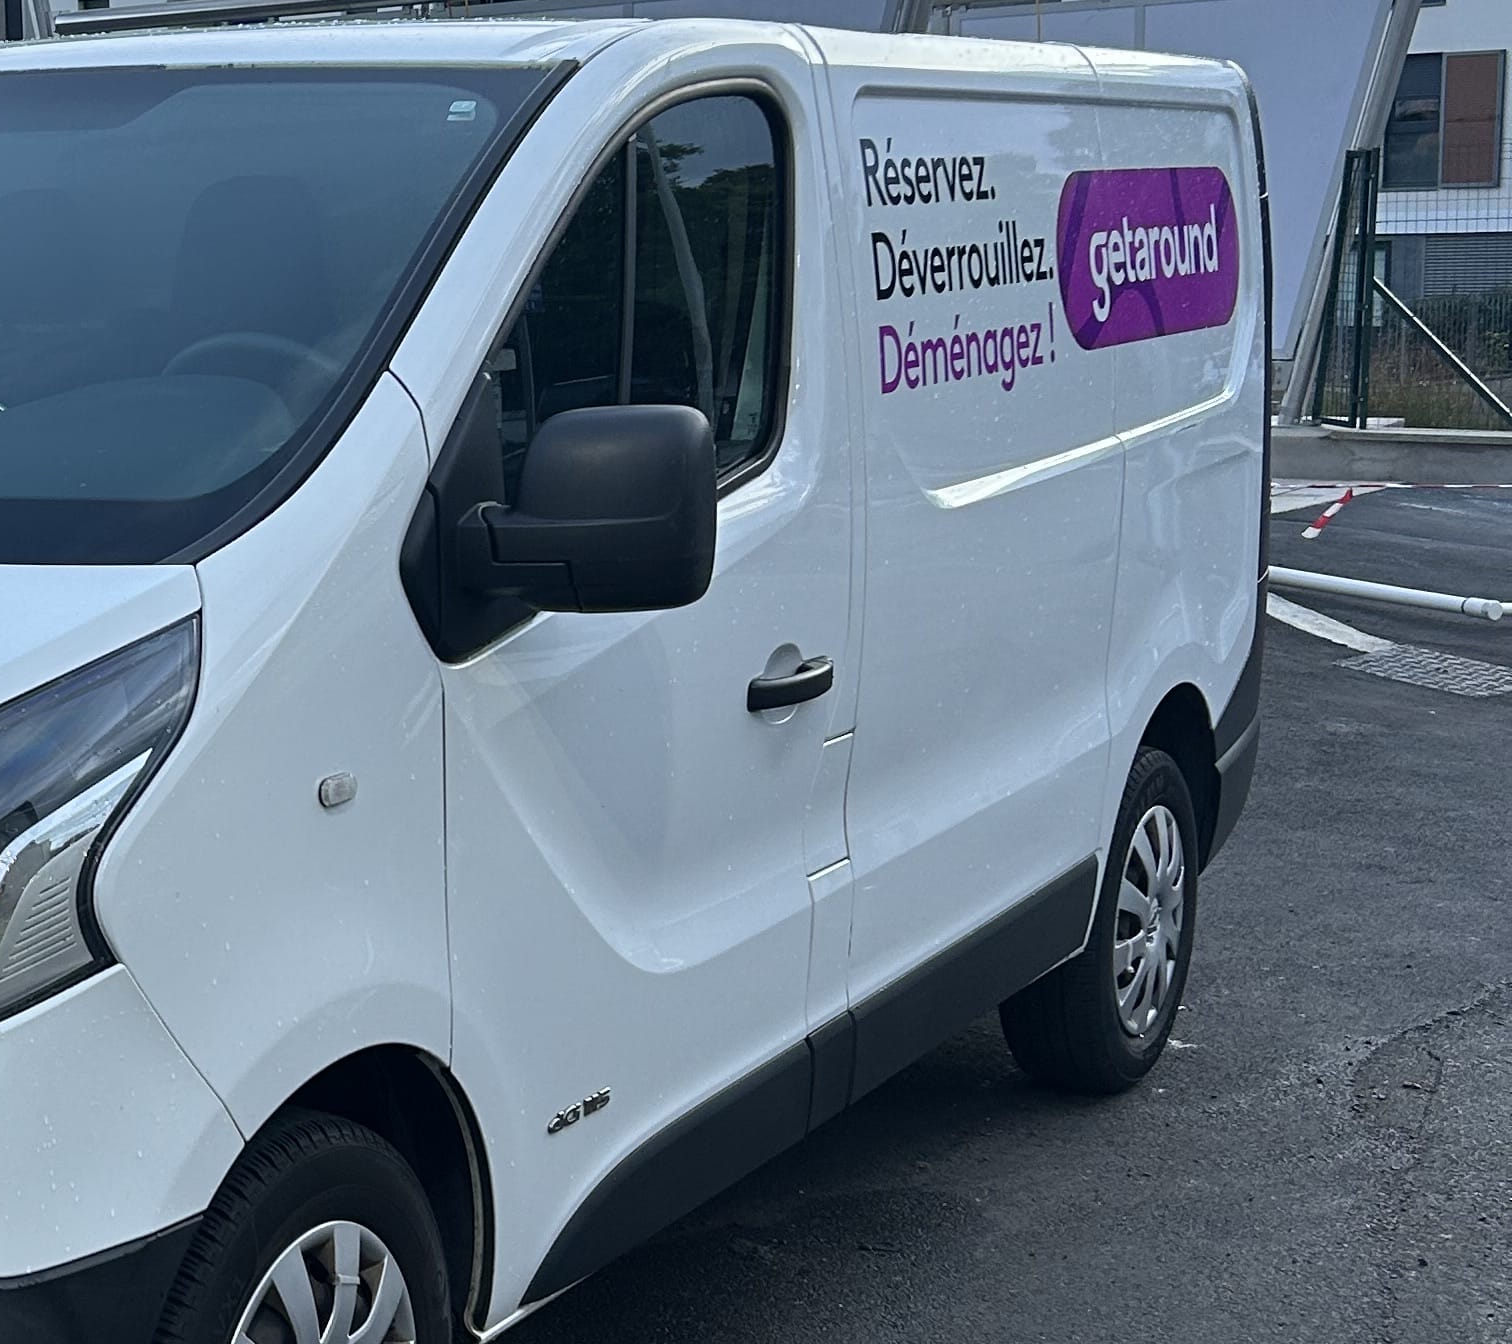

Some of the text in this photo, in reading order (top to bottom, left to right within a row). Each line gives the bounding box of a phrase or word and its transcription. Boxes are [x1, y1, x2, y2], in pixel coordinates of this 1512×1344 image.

[859, 137, 996, 207] Réservez.
[871, 220, 1054, 301] Déverrouillez.
[1089, 204, 1219, 322] getaround
